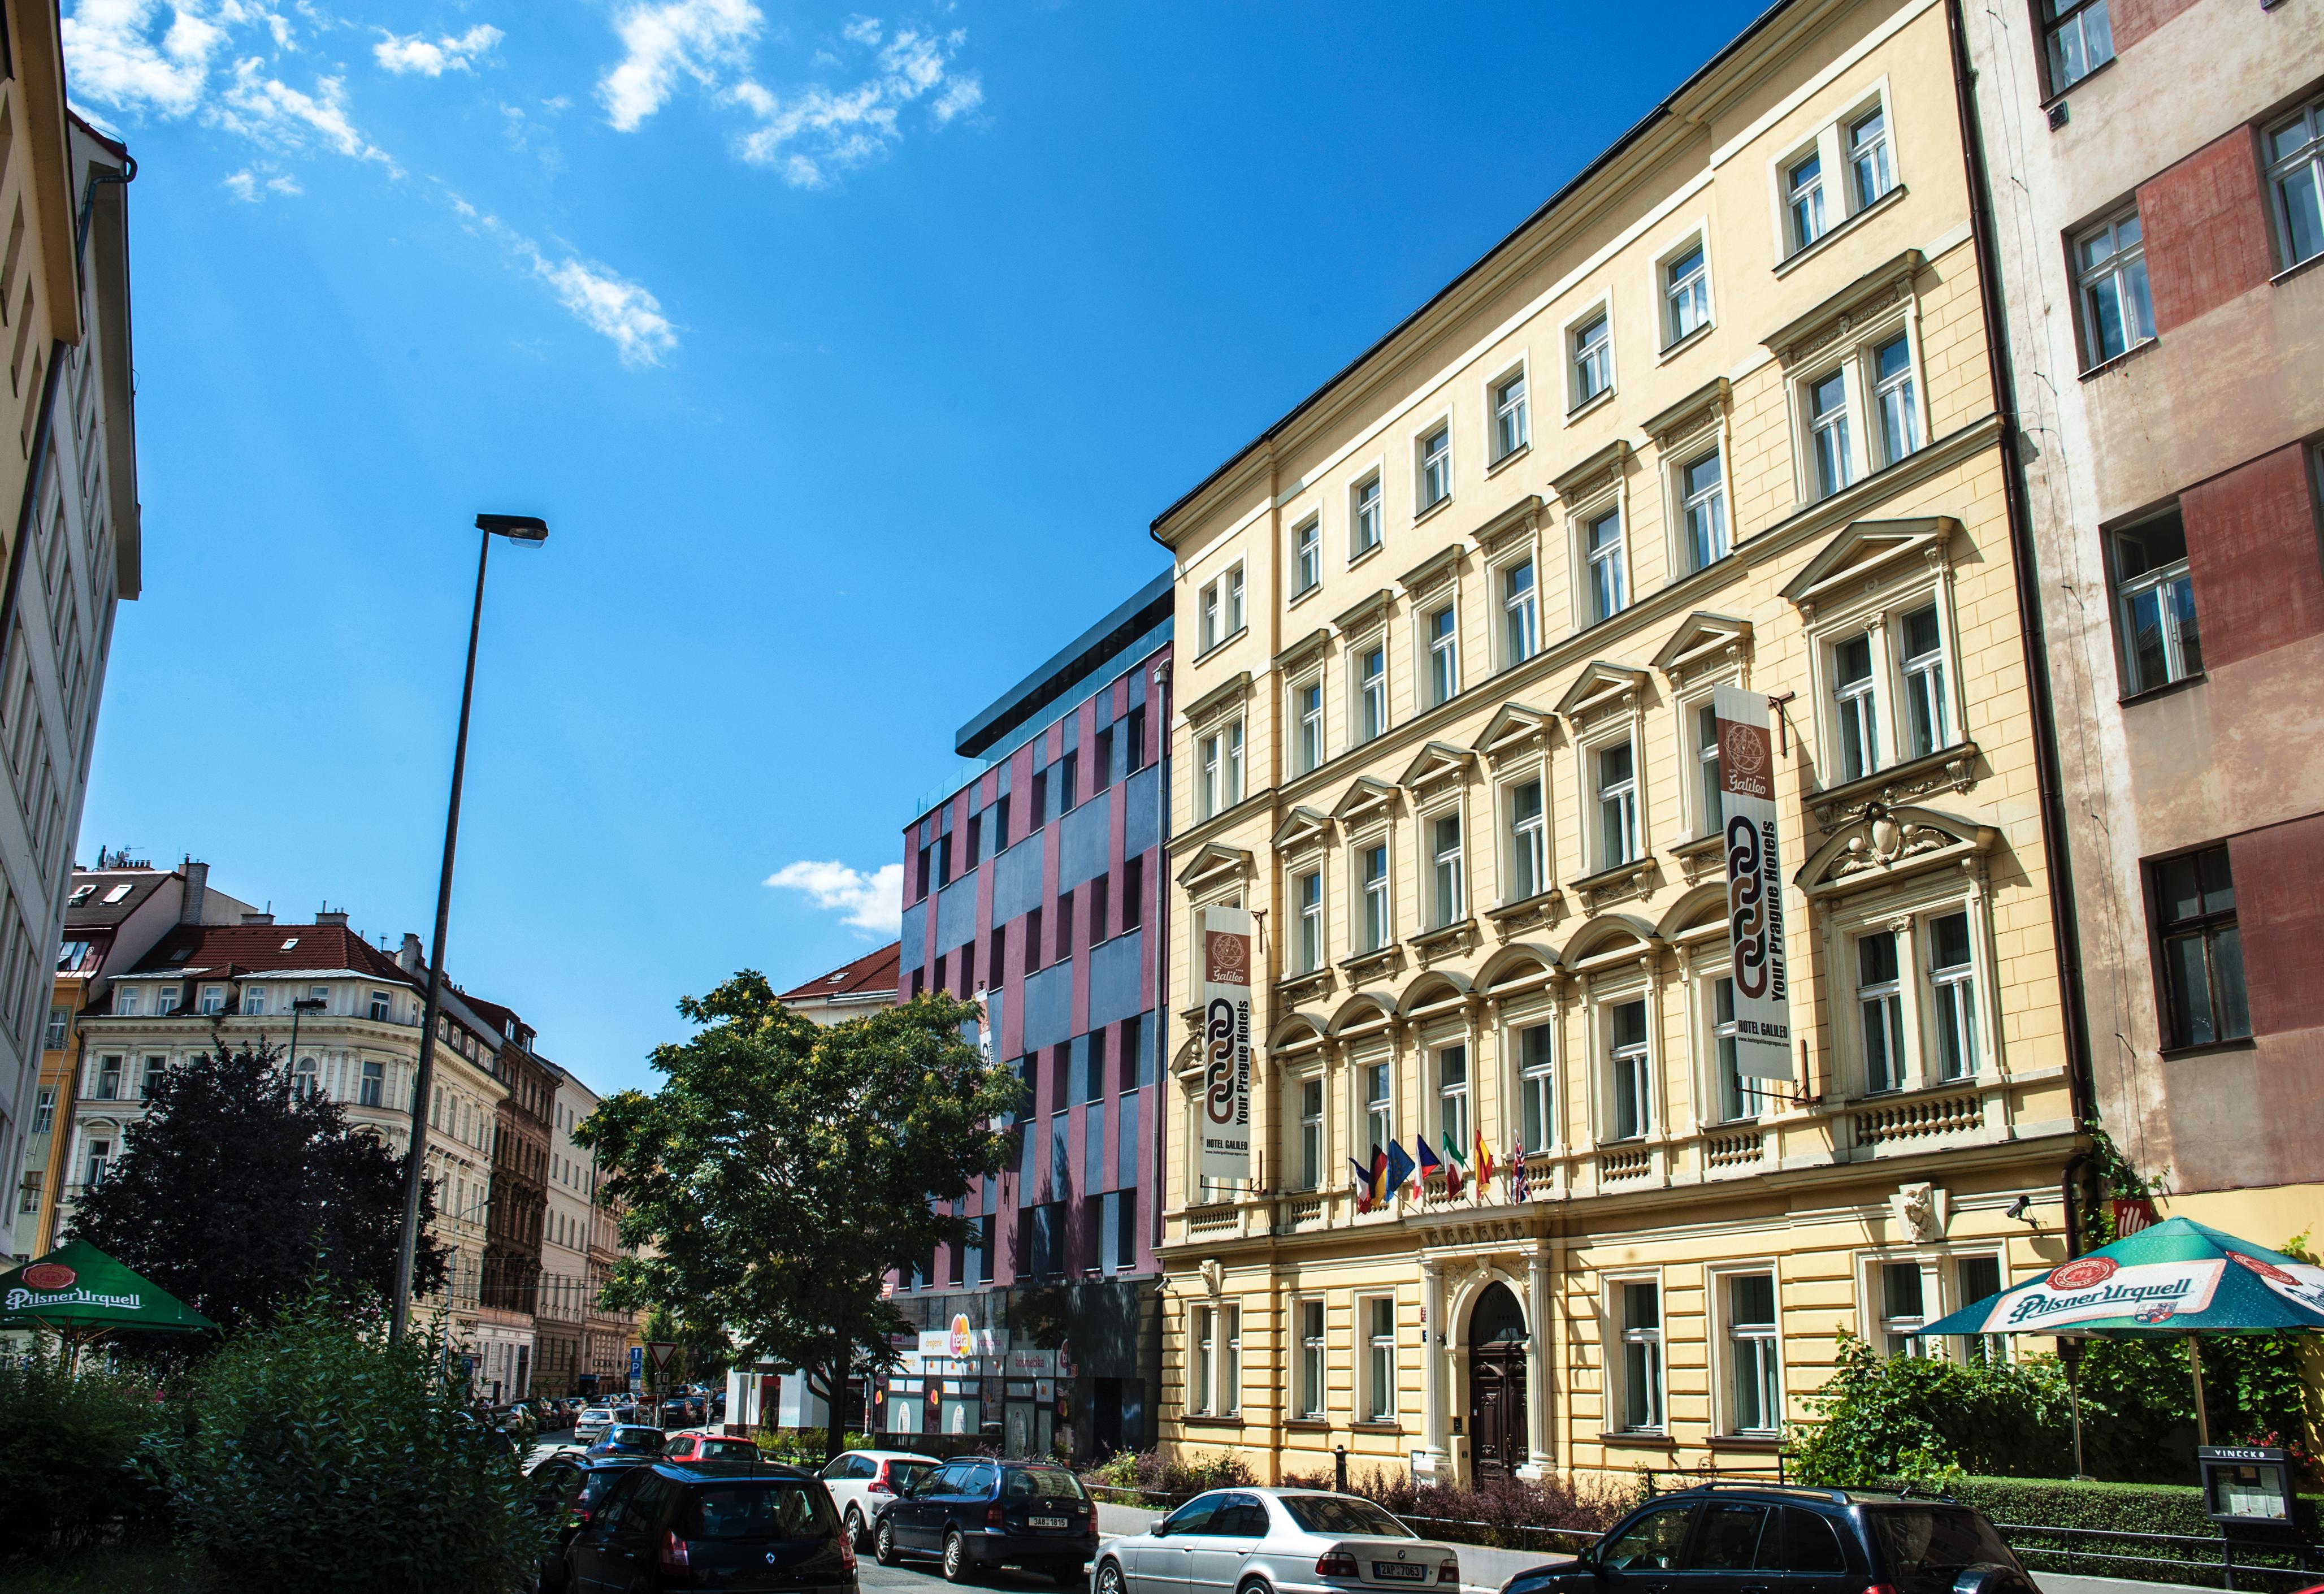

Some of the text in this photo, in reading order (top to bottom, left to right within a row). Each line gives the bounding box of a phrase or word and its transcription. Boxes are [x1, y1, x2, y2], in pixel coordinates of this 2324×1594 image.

[1729, 774, 1766, 795] Galileo
[1761, 820, 1785, 1002] Your Prague Hotels
[1212, 969, 1243, 982] Galileo
[1738, 1020, 1788, 1039] HOTEL GALILEO
[1236, 1000, 1250, 1125] Your Prague Hotels
[1207, 1139, 1248, 1150] HOTEL GALILEO
[5, 1287, 142, 1310] Pilsner Urquell
[2008, 1278, 2193, 1324] Pilsner Urquell
[952, 1331, 968, 1348] teta
[632, 1363, 639, 1373] P
[1015, 1355, 1044, 1368] kosmetika
[1381, 1565, 1420, 1576] 2AP 7063
